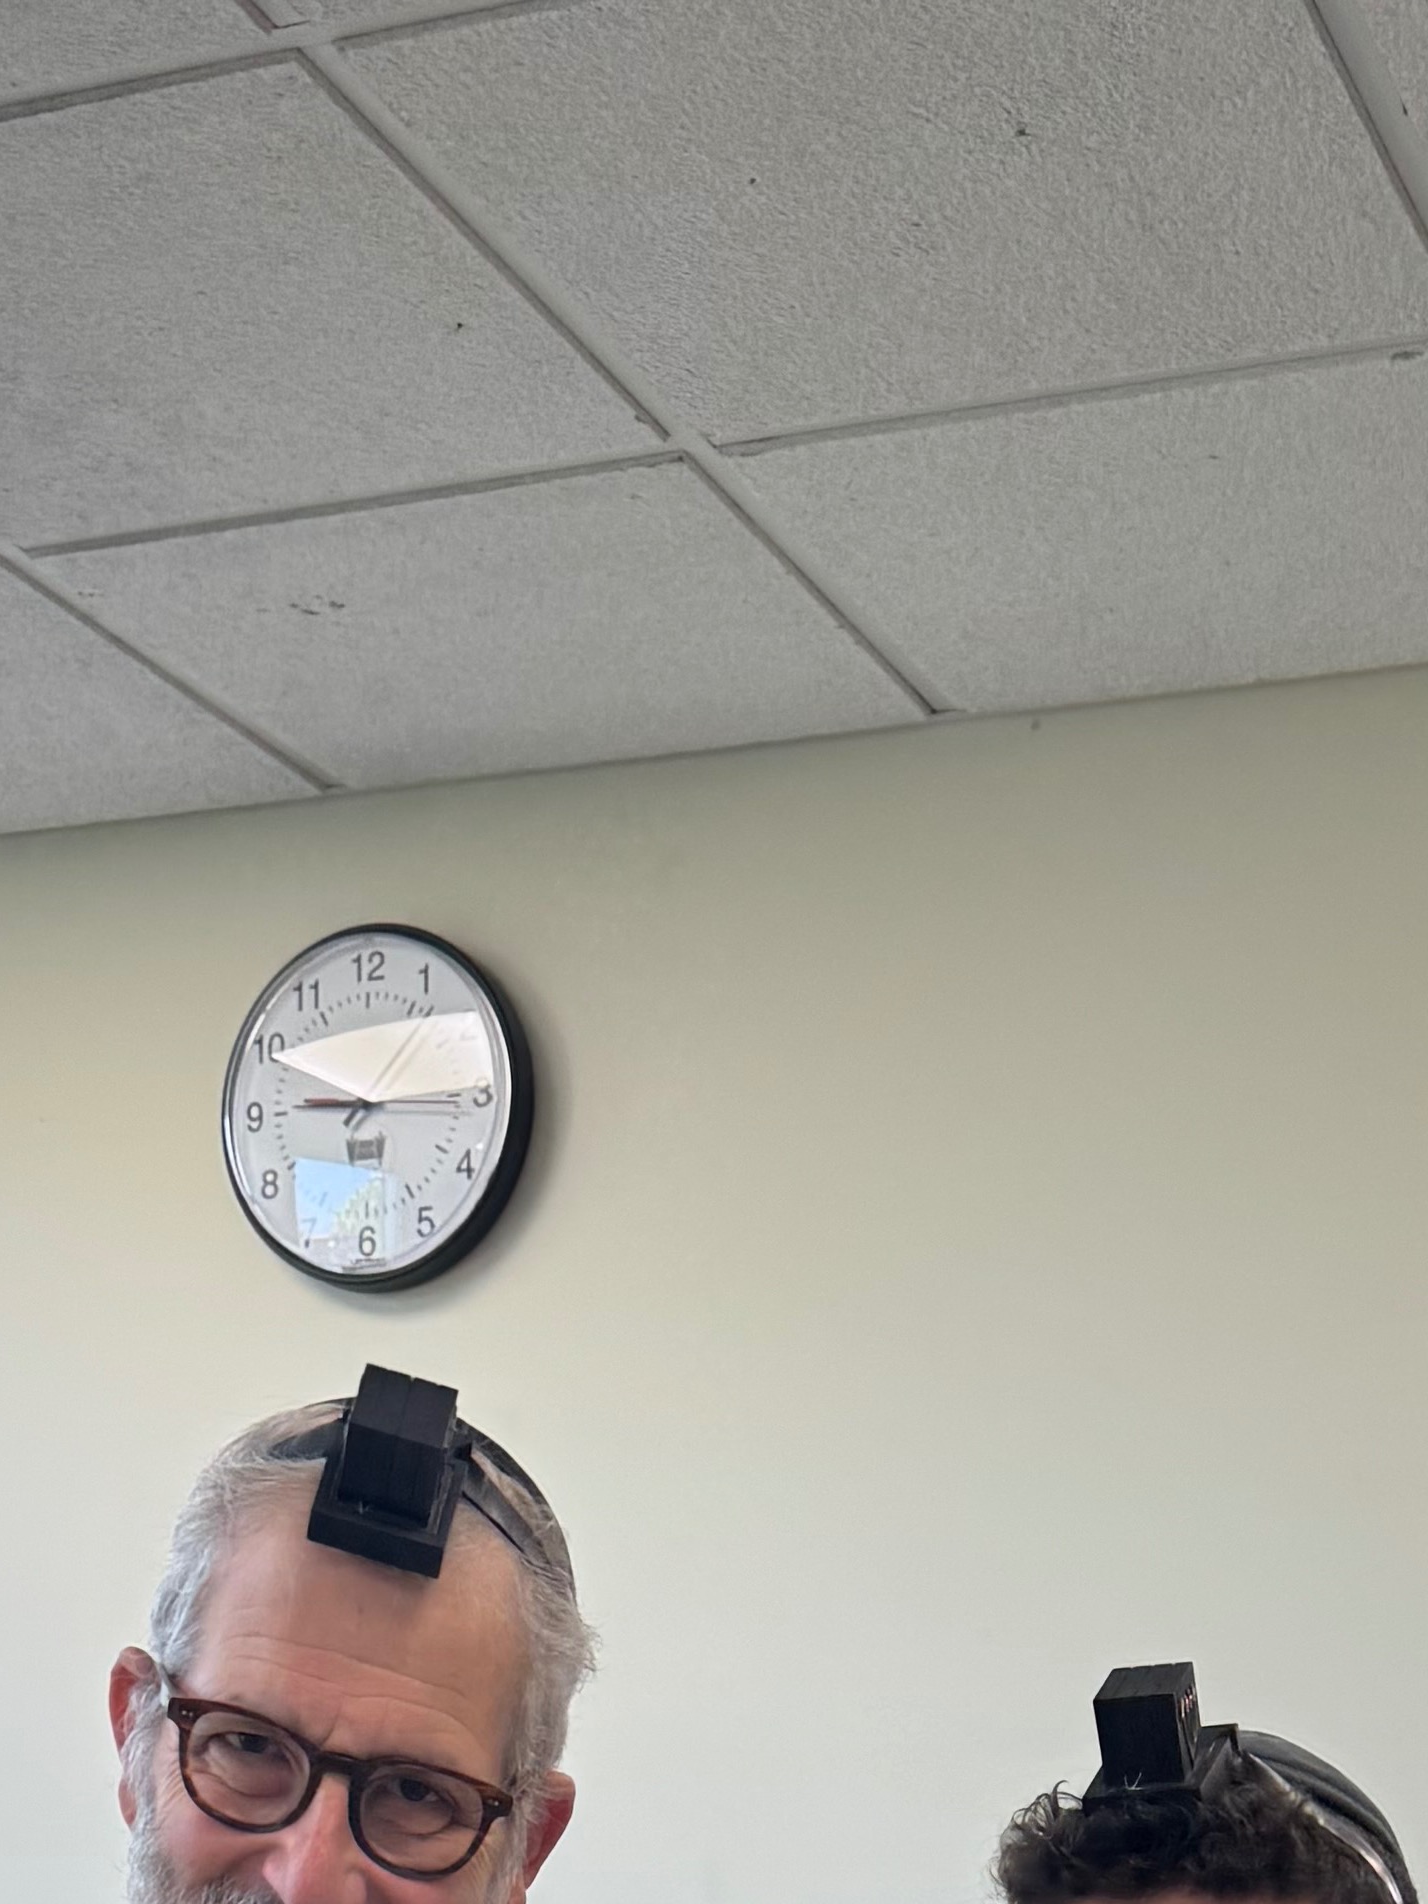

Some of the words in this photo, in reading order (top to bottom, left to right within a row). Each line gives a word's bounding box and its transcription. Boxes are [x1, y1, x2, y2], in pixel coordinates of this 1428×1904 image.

[352, 951, 385, 982] 12
[418, 963, 430, 995] 1
[293, 979, 320, 1011] 11
[254, 1033, 285, 1064] 10
[473, 1078, 493, 1107] 3
[246, 1102, 264, 1132] 9
[456, 1149, 475, 1180] 4
[261, 1170, 279, 1199] 8
[302, 1218, 318, 1248] 7
[417, 1207, 435, 1238] 5
[358, 1226, 376, 1257] 6
